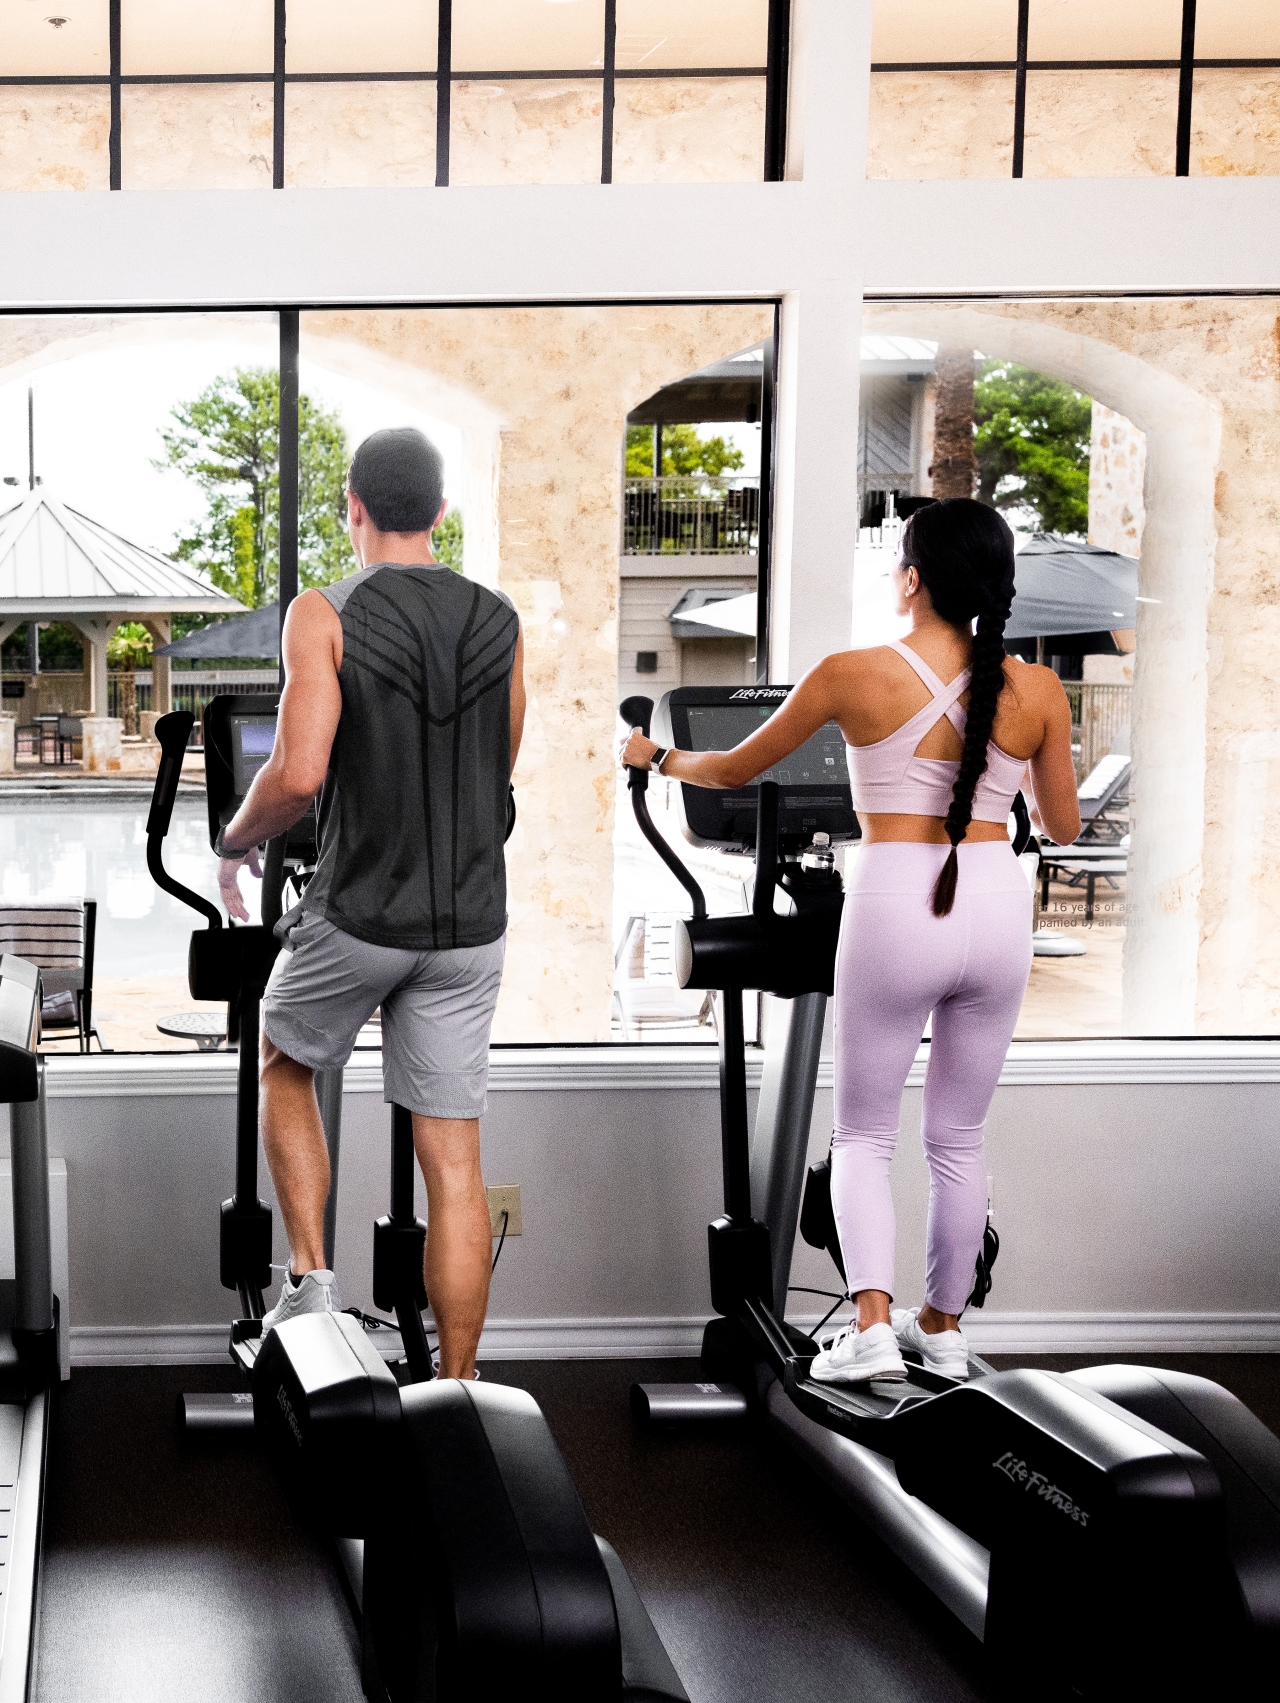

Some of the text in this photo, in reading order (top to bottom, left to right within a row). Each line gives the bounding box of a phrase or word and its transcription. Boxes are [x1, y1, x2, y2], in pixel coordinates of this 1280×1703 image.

[1053, 902, 1067, 912] 16
[1071, 903, 1100, 915] years
[1104, 902, 1116, 912] of
[1119, 903, 1139, 914] age
[1081, 917, 1094, 930] by
[1098, 918, 1112, 928] an
